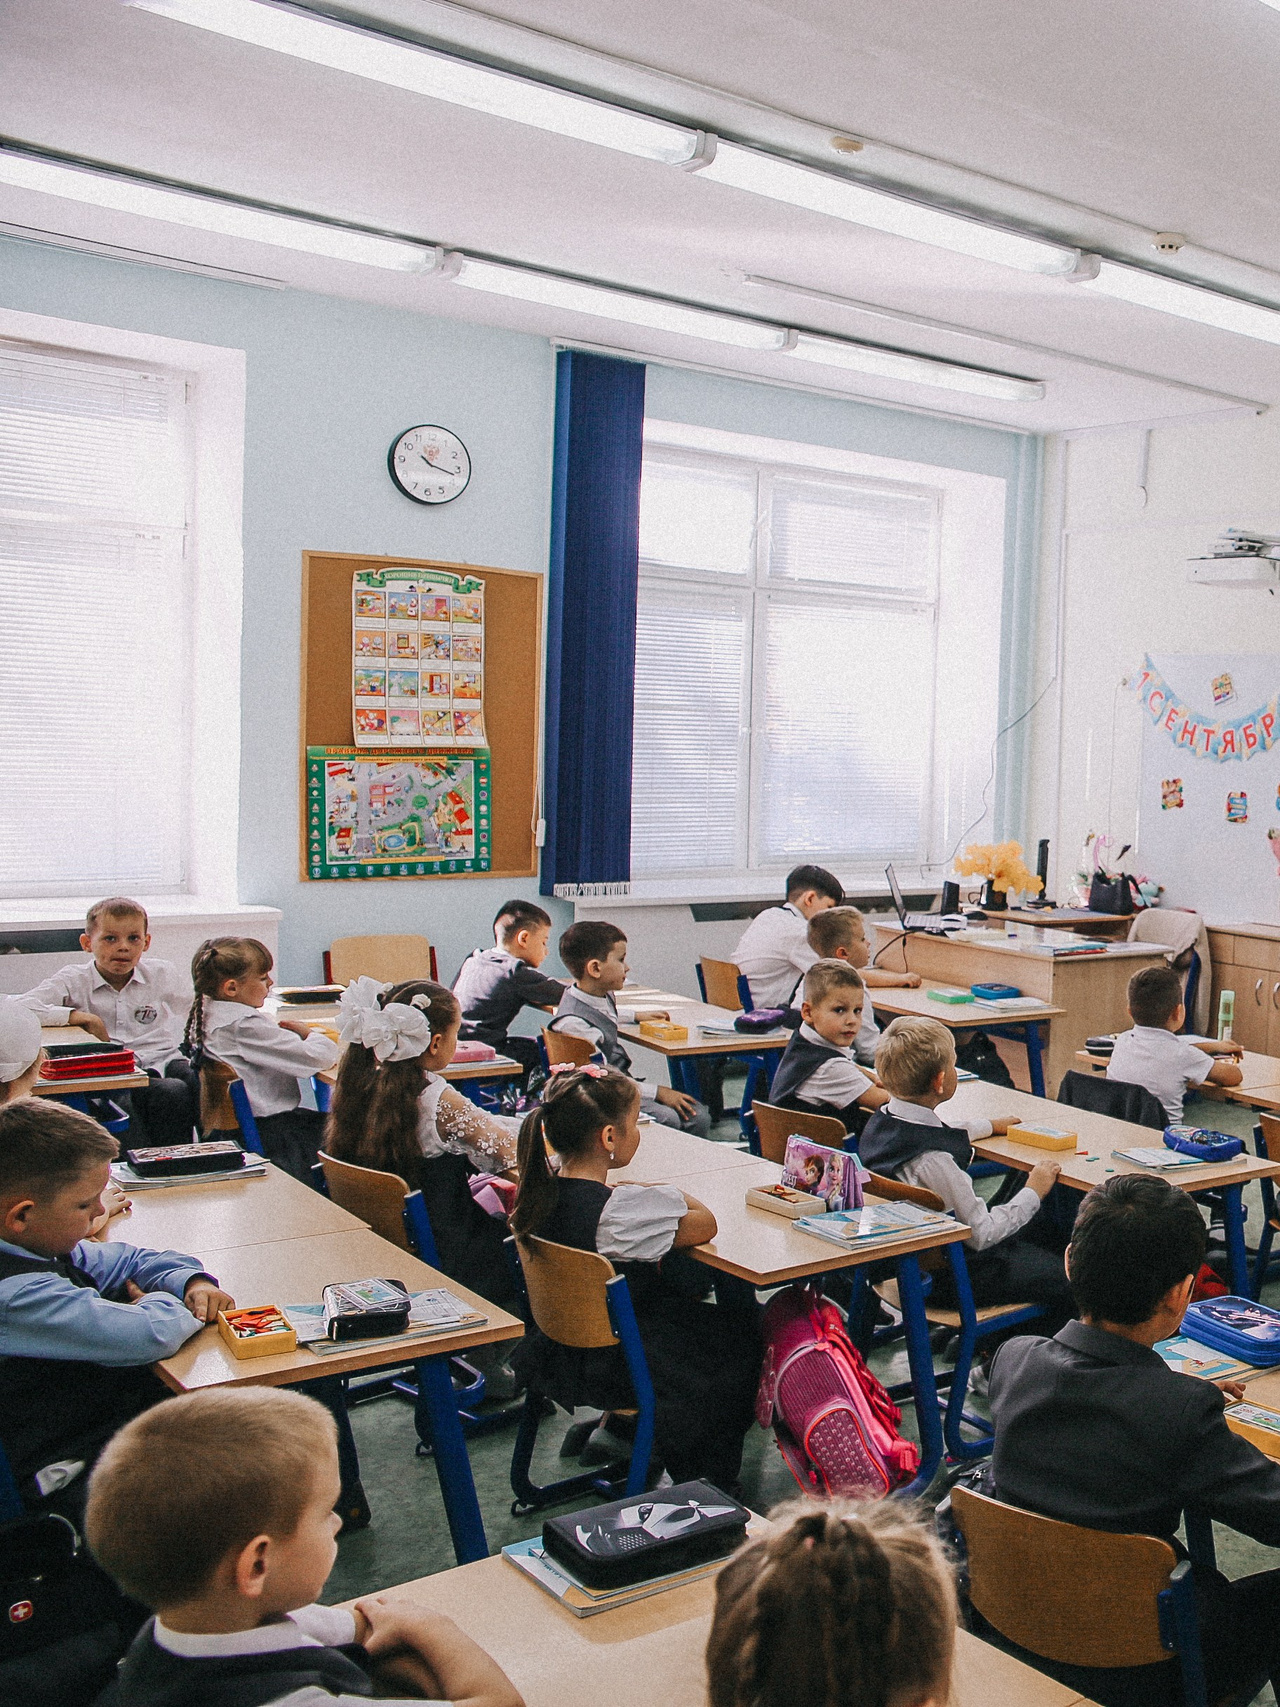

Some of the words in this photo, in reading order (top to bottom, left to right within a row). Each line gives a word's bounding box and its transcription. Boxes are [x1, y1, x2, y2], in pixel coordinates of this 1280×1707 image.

[398, 455, 406, 463] 9
[451, 451, 458, 460] 2
[454, 465, 461, 474] 3
[424, 487, 432, 496] 6
[438, 486, 445, 494] 5
